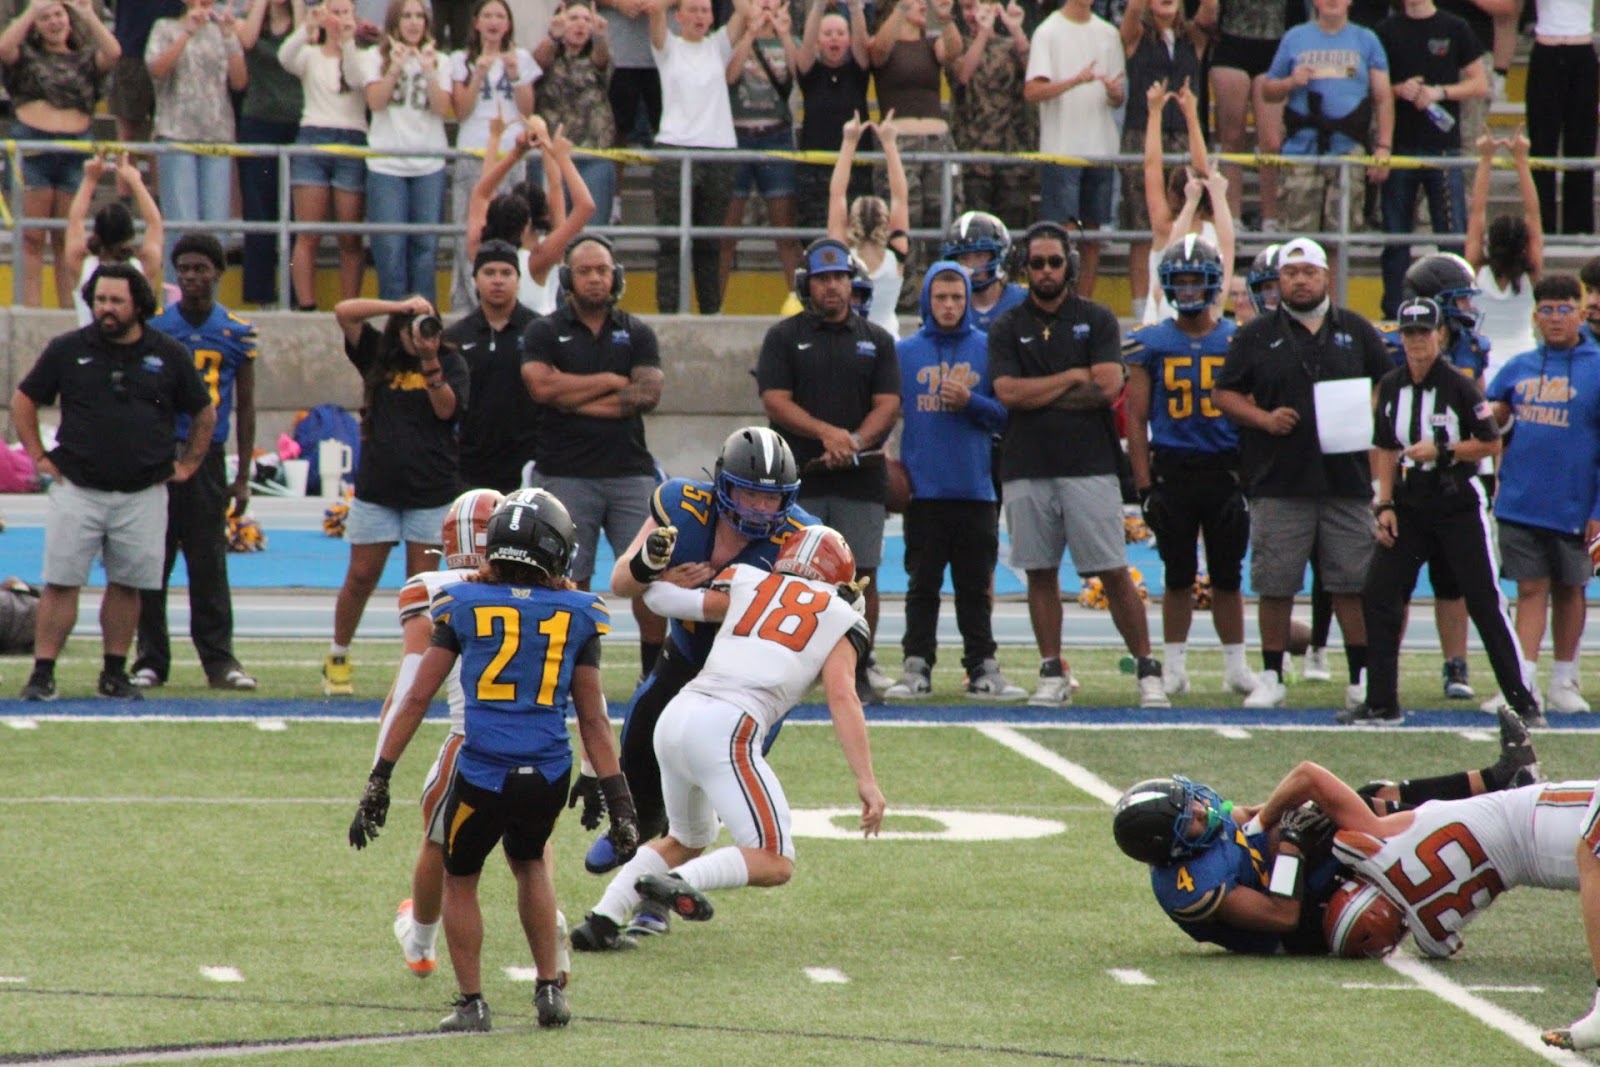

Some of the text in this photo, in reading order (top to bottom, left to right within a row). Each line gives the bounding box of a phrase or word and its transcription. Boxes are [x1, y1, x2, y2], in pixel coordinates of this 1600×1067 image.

[1163, 356, 1226, 419] 55
[680, 484, 712, 526] 57
[498, 546, 528, 557] schutt
[732, 573, 832, 653] 18
[473, 606, 571, 706] 21
[1176, 865, 1195, 892] 4
